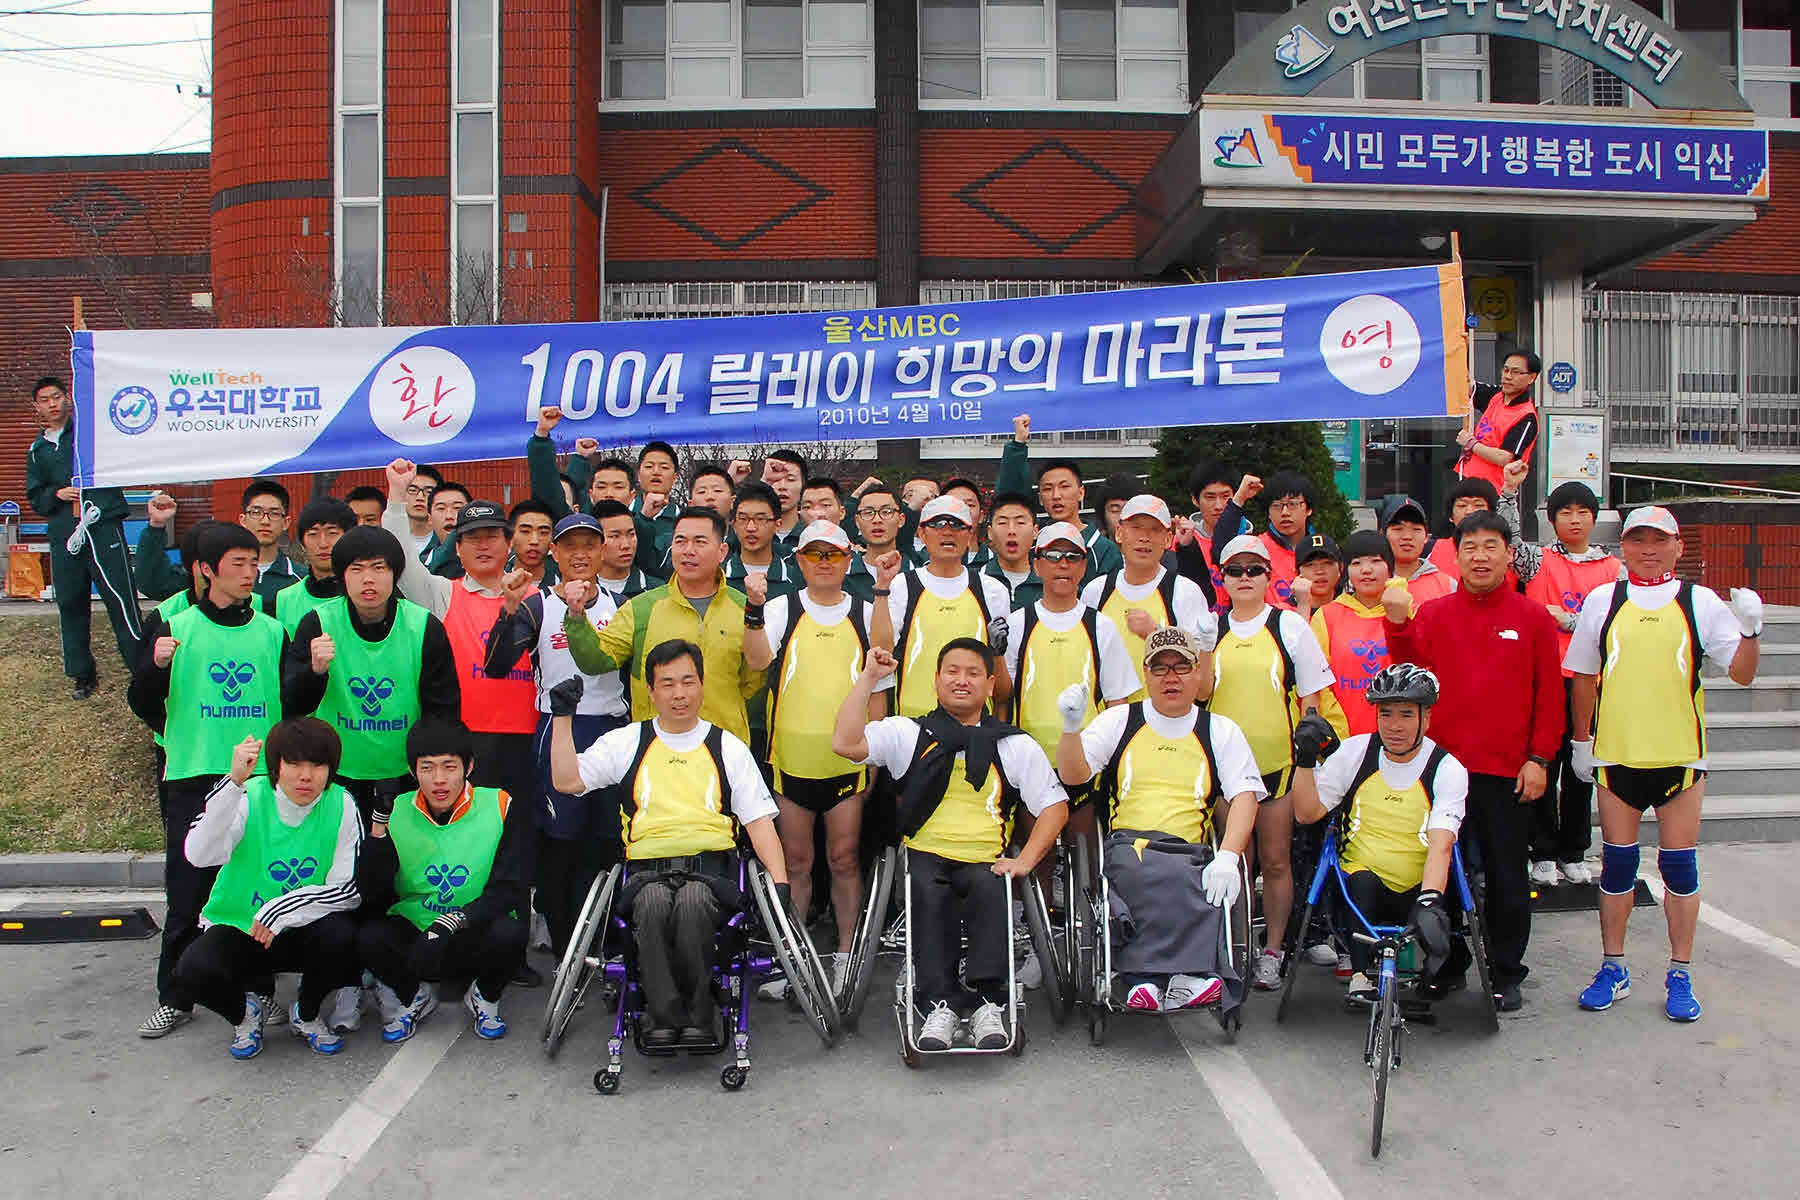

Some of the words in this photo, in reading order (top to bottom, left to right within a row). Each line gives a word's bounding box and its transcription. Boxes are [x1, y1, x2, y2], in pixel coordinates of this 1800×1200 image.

[1323, 132, 1384, 170] 시민
[1396, 136, 1489, 175] 모두가
[1500, 137, 1594, 177] 행복한
[1603, 141, 1662, 179] 도시
[1674, 143, 1734, 182] 익산
[823, 313, 961, 344] 울산MBC
[1341, 319, 1393, 370] 영
[521, 342, 685, 422] 1004
[709, 350, 876, 416] 릴레이
[891, 331, 1063, 400] 희망의
[1082, 303, 1288, 389] 마라톤
[169, 371, 265, 386] WellTech
[1552, 372, 1573, 383] ADT
[165, 386, 322, 417] 우석대학교
[392, 362, 457, 428] 환
[167, 418, 234, 433] WOOSUK
[238, 415, 319, 431] UNIVERSITY
[820, 406, 889, 426] 2010년
[897, 403, 929, 423] 4월
[939, 400, 982, 421] 10일
[200, 702, 267, 719] hummel
[337, 711, 409, 732] hummel
